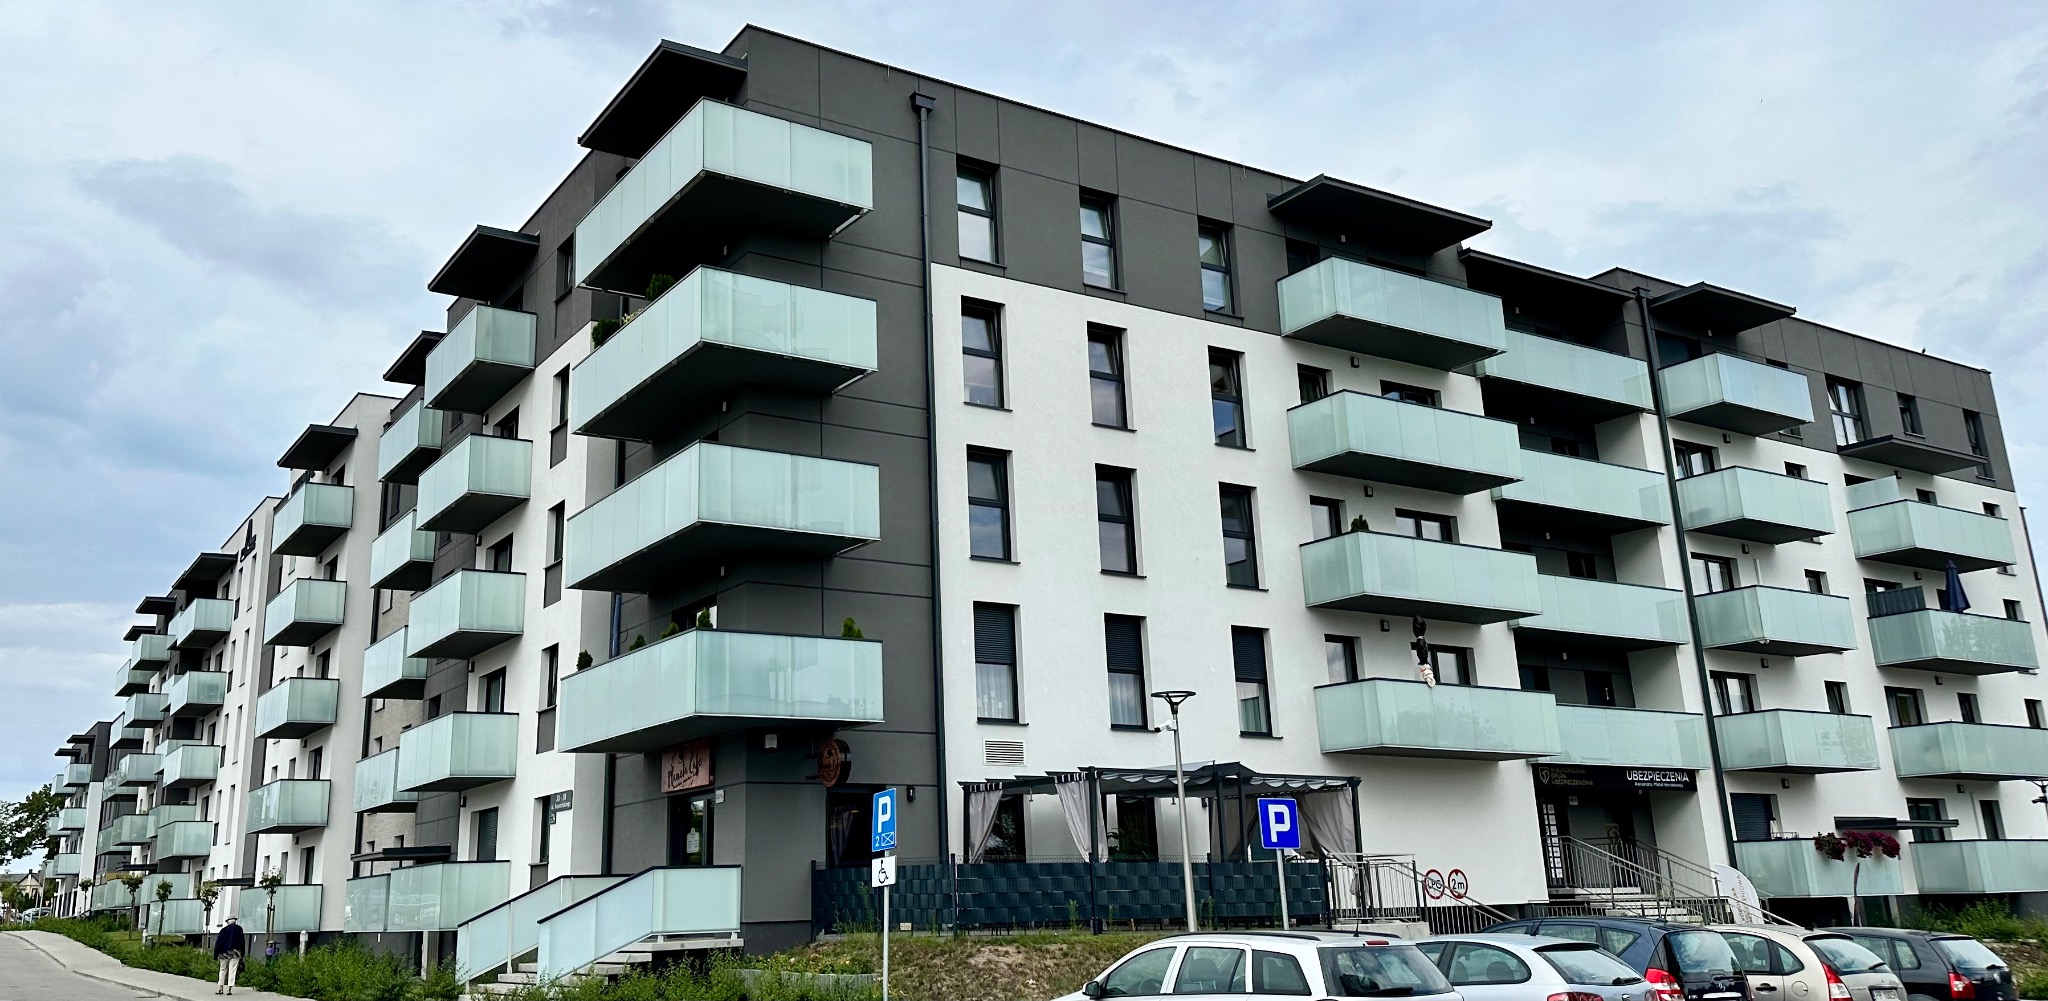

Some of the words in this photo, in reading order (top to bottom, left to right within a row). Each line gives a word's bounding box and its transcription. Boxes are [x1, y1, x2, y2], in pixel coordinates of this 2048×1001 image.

[1626, 770, 1690, 782] UBEZPIECZENIA
[877, 795, 892, 834] P
[1267, 804, 1291, 843] P
[875, 835, 880, 847] 2
